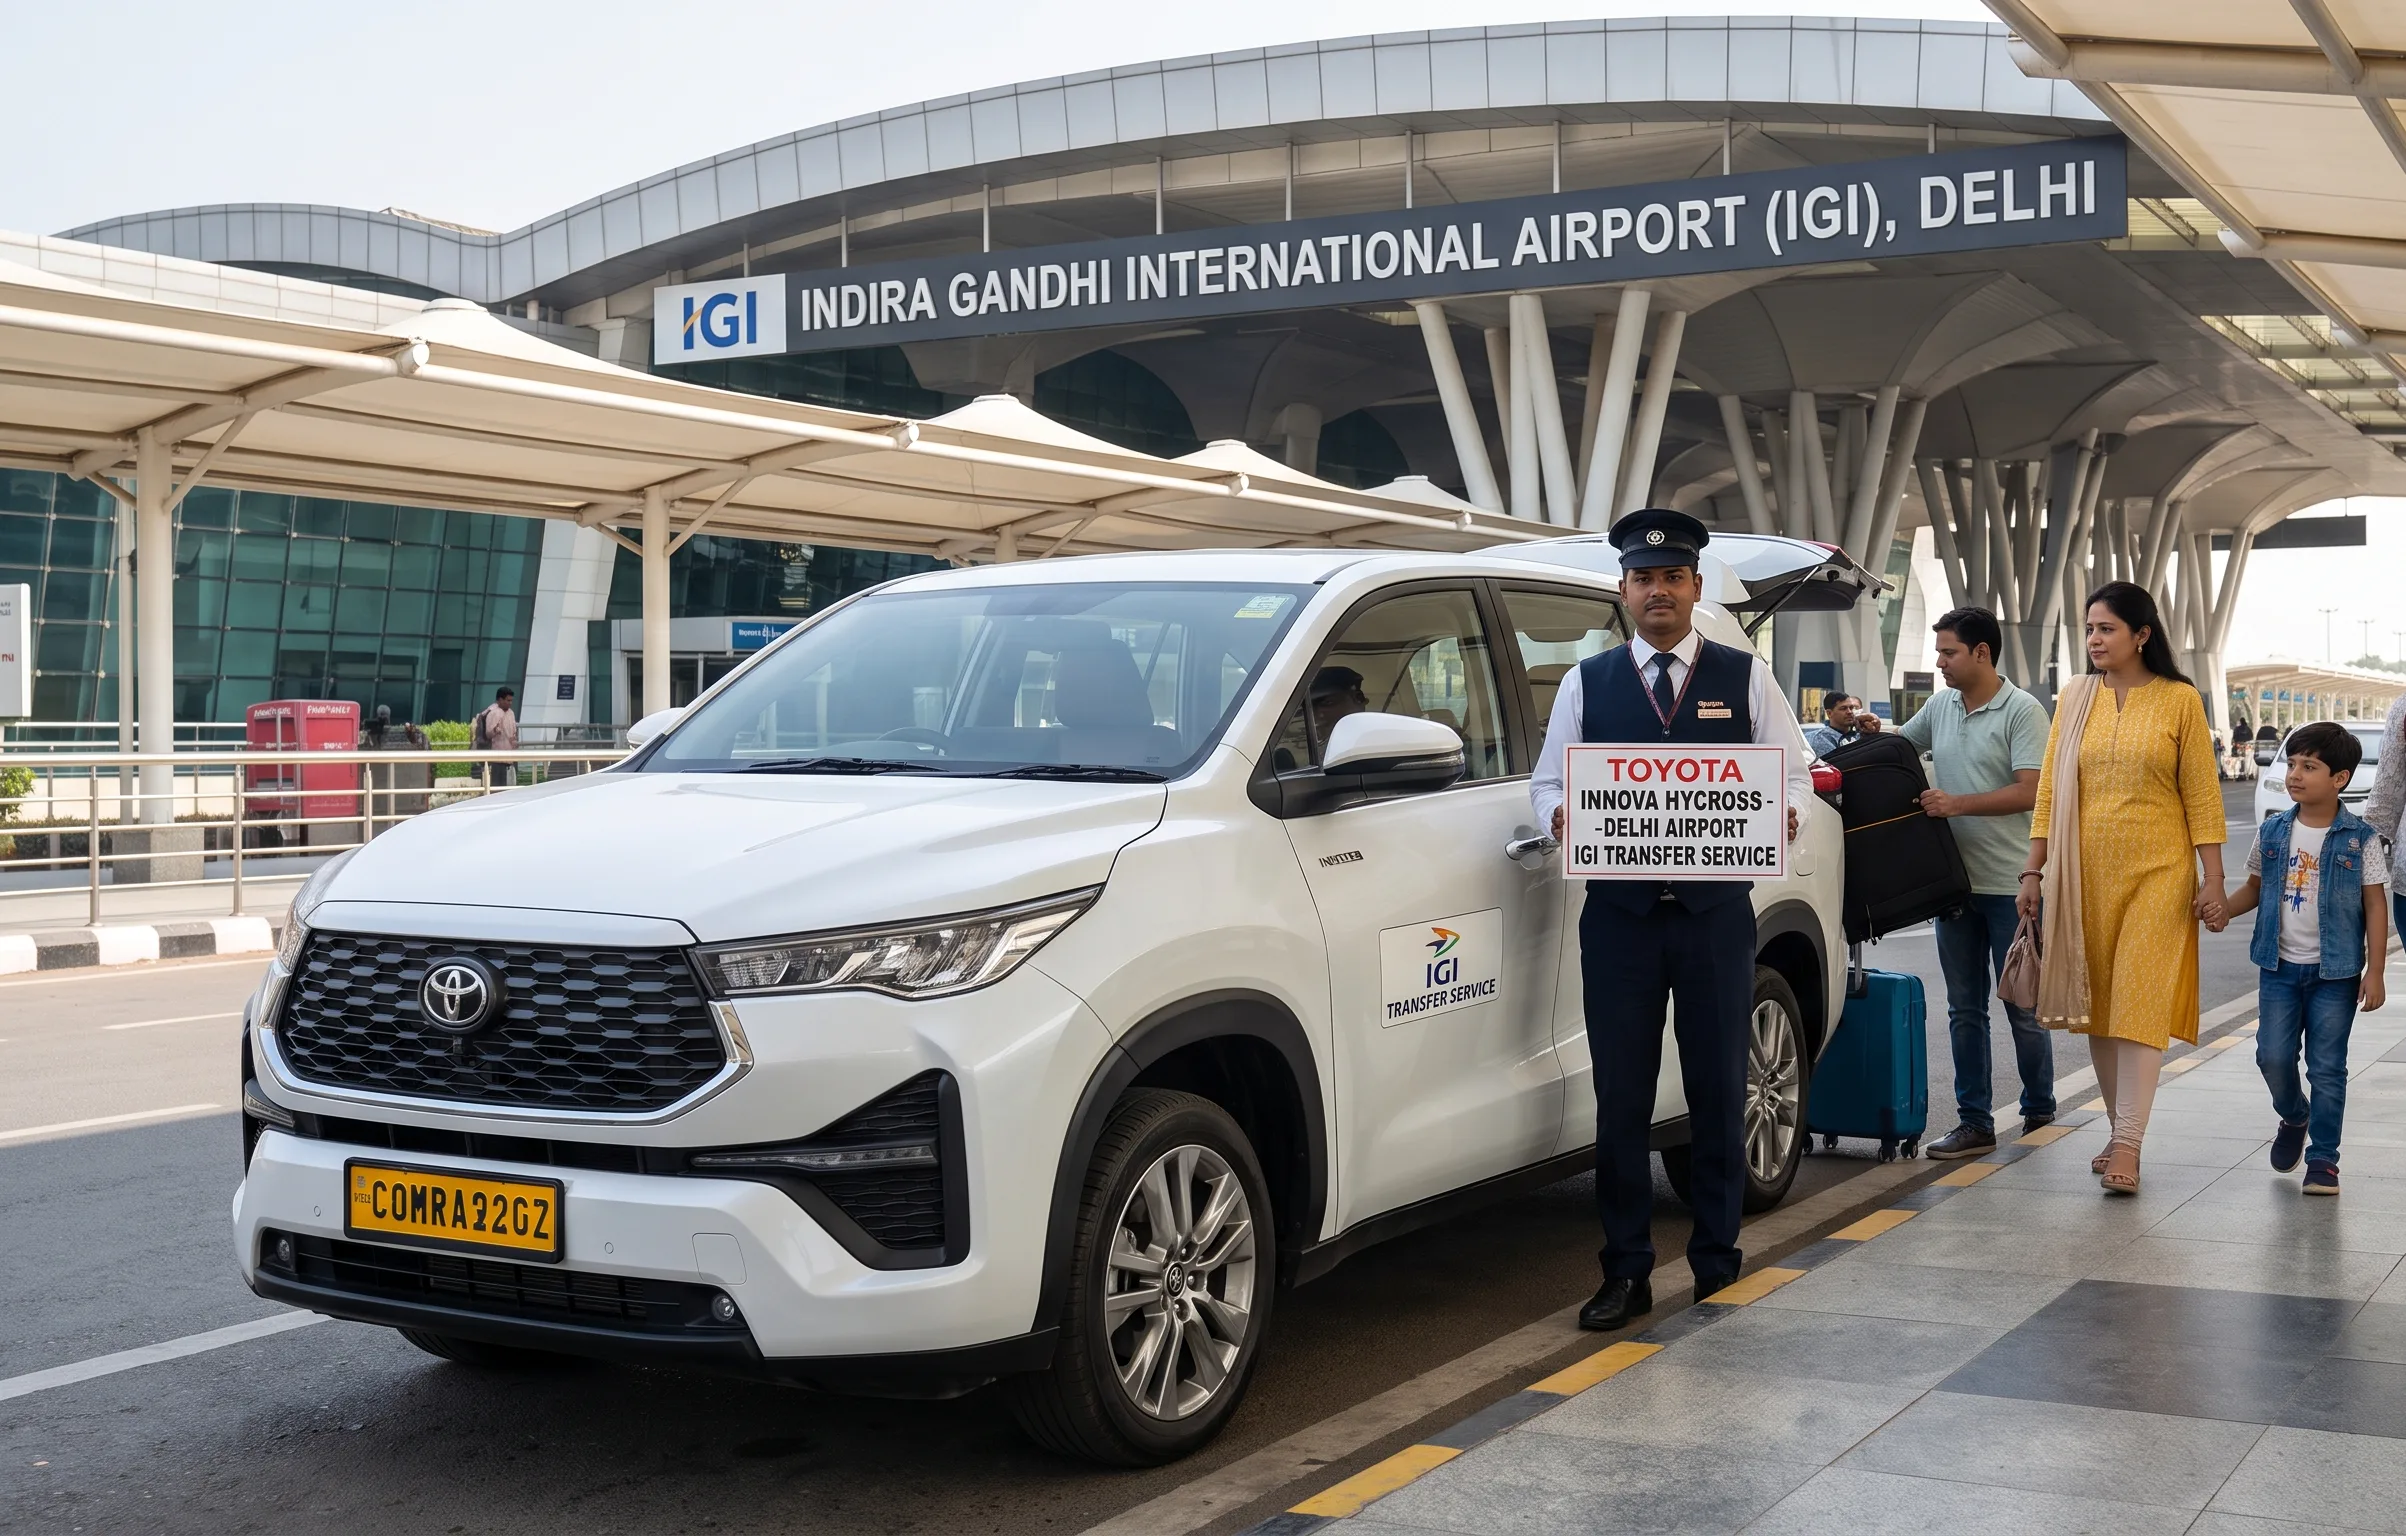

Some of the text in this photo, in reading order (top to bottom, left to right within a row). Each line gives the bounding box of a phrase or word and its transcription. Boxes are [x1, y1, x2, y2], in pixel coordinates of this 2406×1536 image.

[802, 160, 2096, 331] INDIRA GANDHI INTERNATIONAL AIRPORT (IGI), DELHI
[683, 290, 757, 350] IGI
[1607, 758, 1744, 783] TOYOTA
[1581, 790, 1659, 810] INNOVA
[1665, 790, 1763, 811] HYCROSS
[1665, 818, 1748, 838] AIRPORT
[1574, 845, 1776, 867] IGI TRANSFER SERVICE
[1426, 957, 1458, 988] IGI
[1387, 978, 1496, 1019] TRANSFER SERVICE
